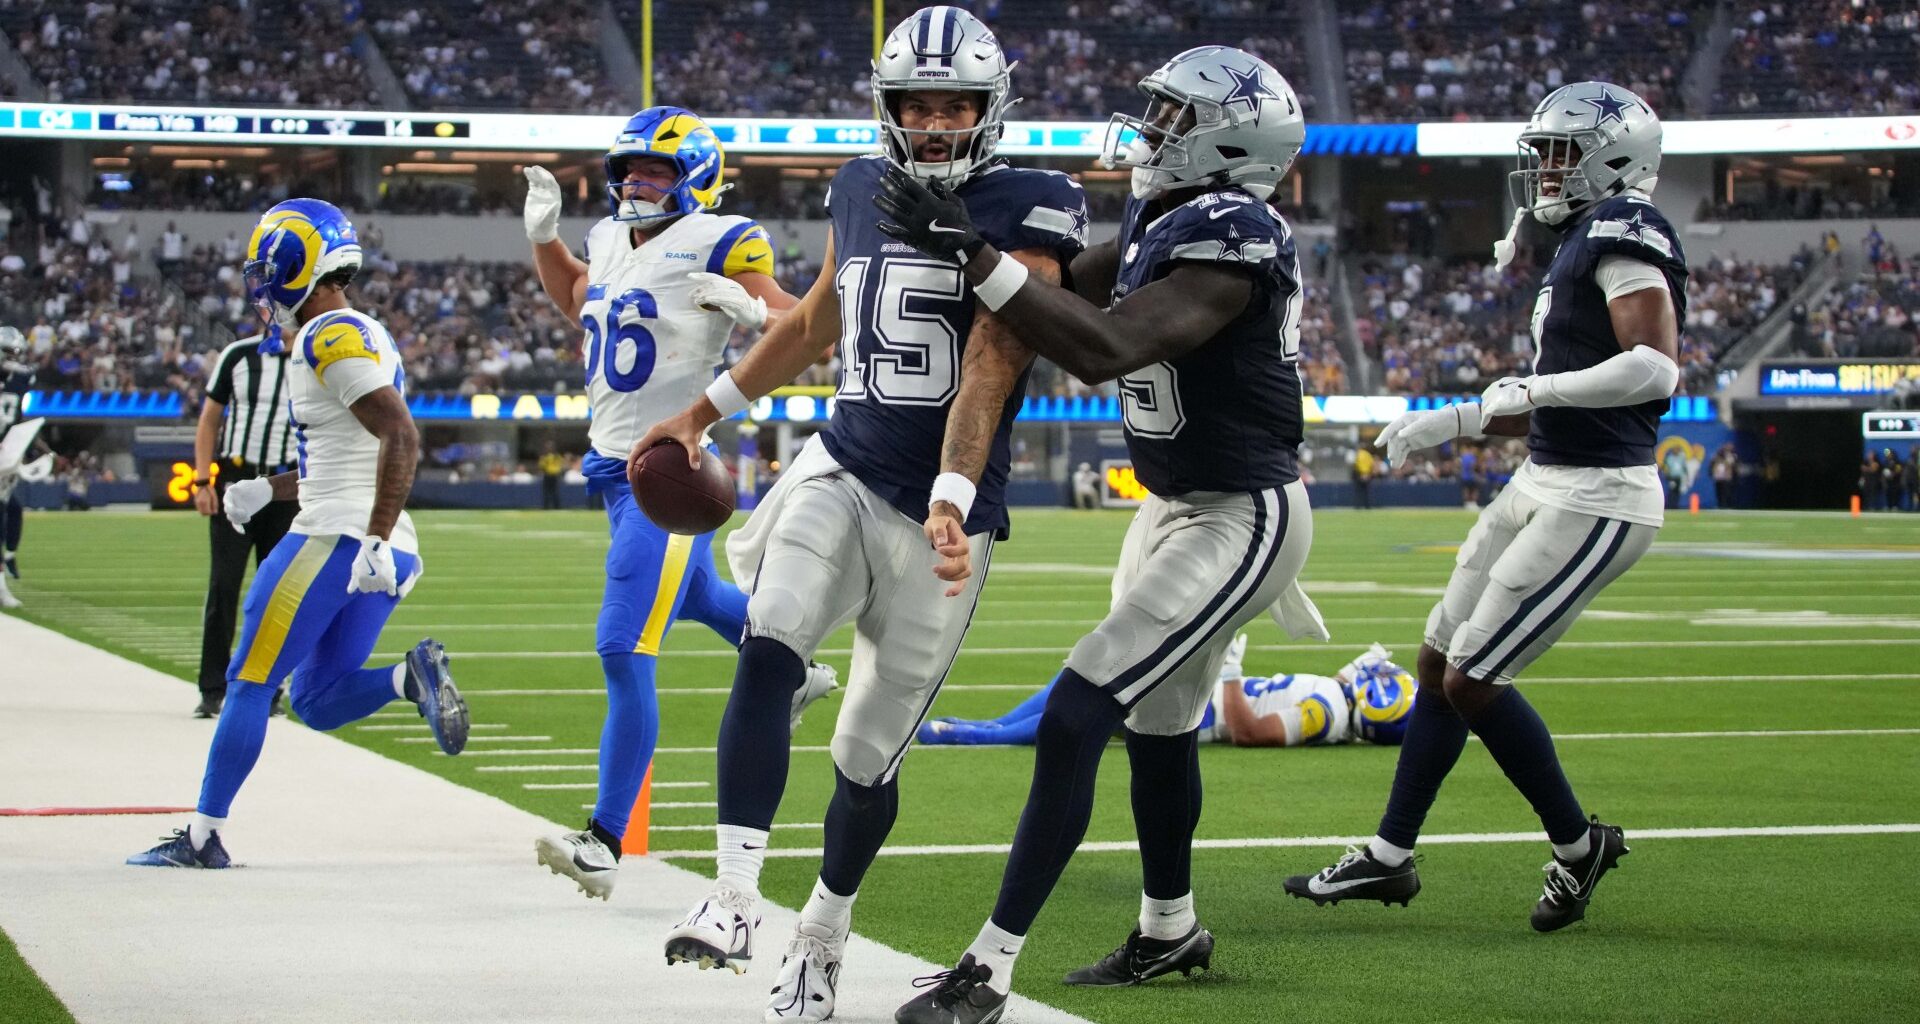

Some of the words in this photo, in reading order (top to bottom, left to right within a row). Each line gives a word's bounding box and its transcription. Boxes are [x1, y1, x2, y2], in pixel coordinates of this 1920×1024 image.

[38, 110, 74, 129] Q4
[114, 112, 160, 131] Pass
[384, 118, 413, 137] 14
[665, 251, 698, 261] RAMS
[581, 283, 659, 393] 56
[835, 256, 965, 407] 15
[470, 394, 589, 419] RAM
